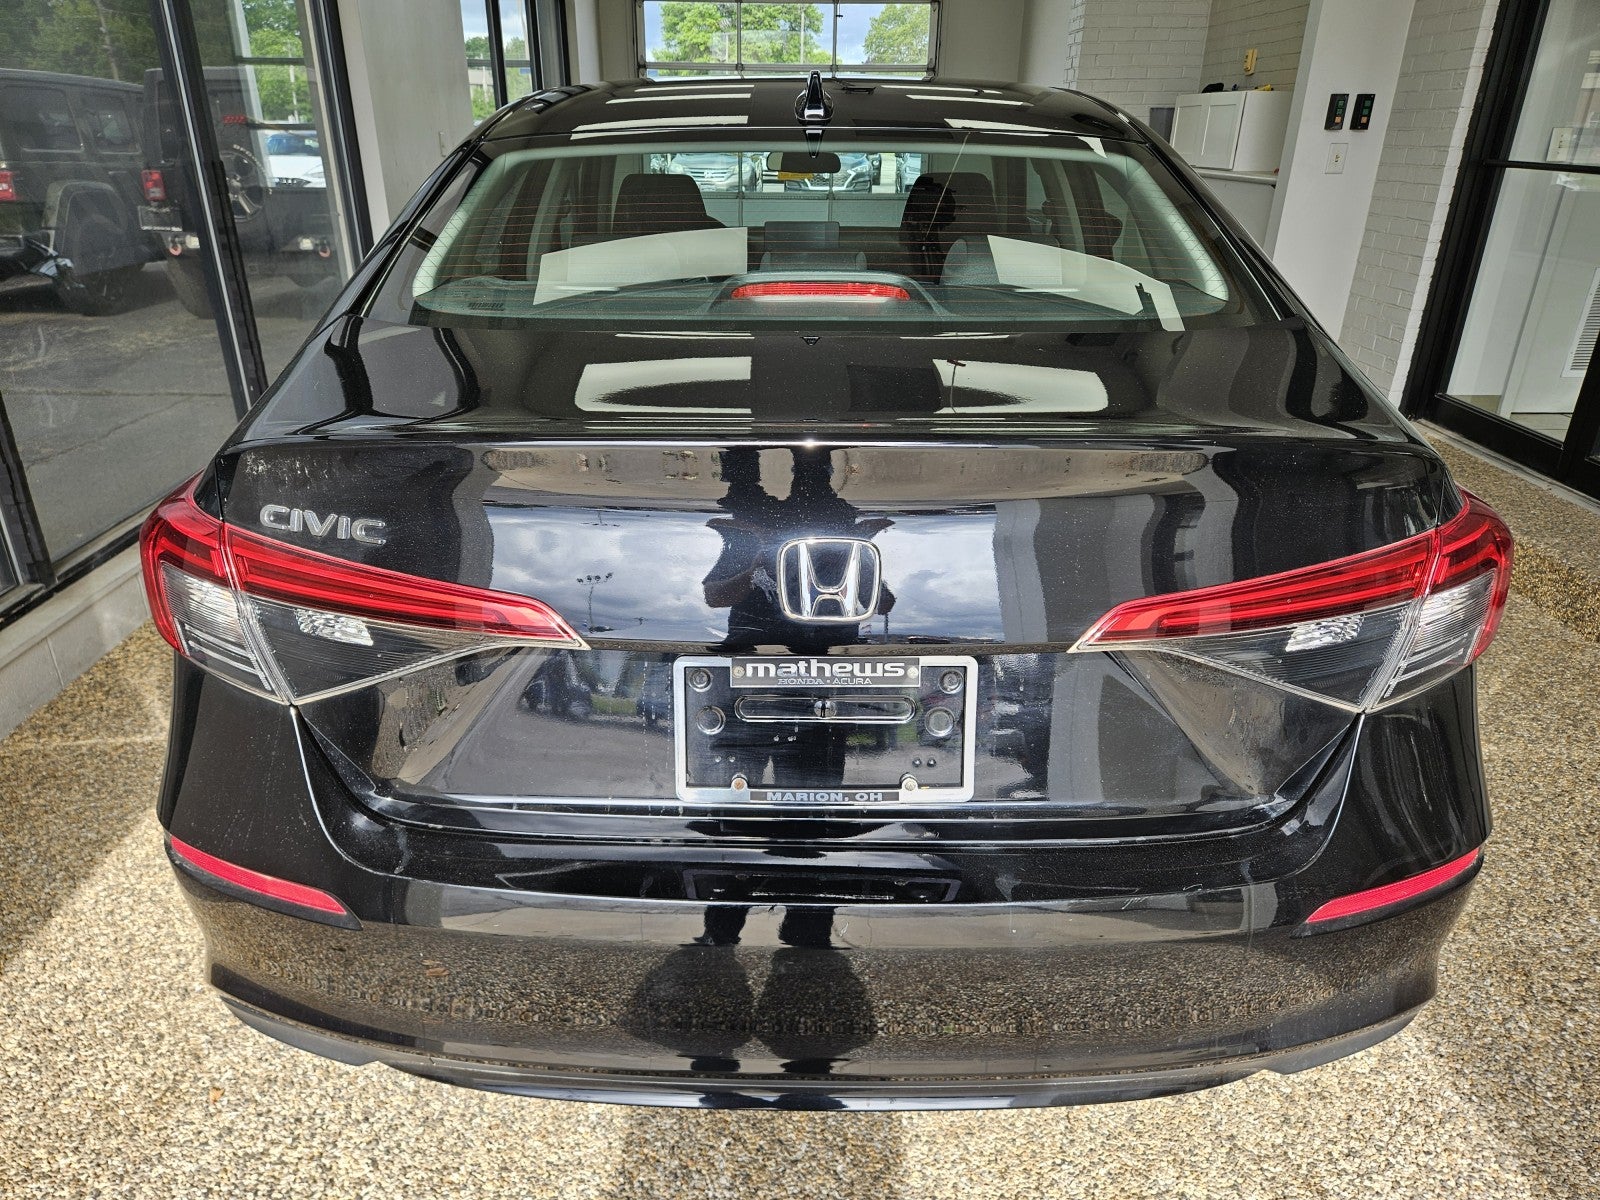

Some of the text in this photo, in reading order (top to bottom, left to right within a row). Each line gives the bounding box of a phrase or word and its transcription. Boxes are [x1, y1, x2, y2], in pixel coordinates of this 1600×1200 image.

[259, 504, 387, 545] CIVIC
[745, 659, 905, 677] mathews
[855, 792, 883, 801] OH
